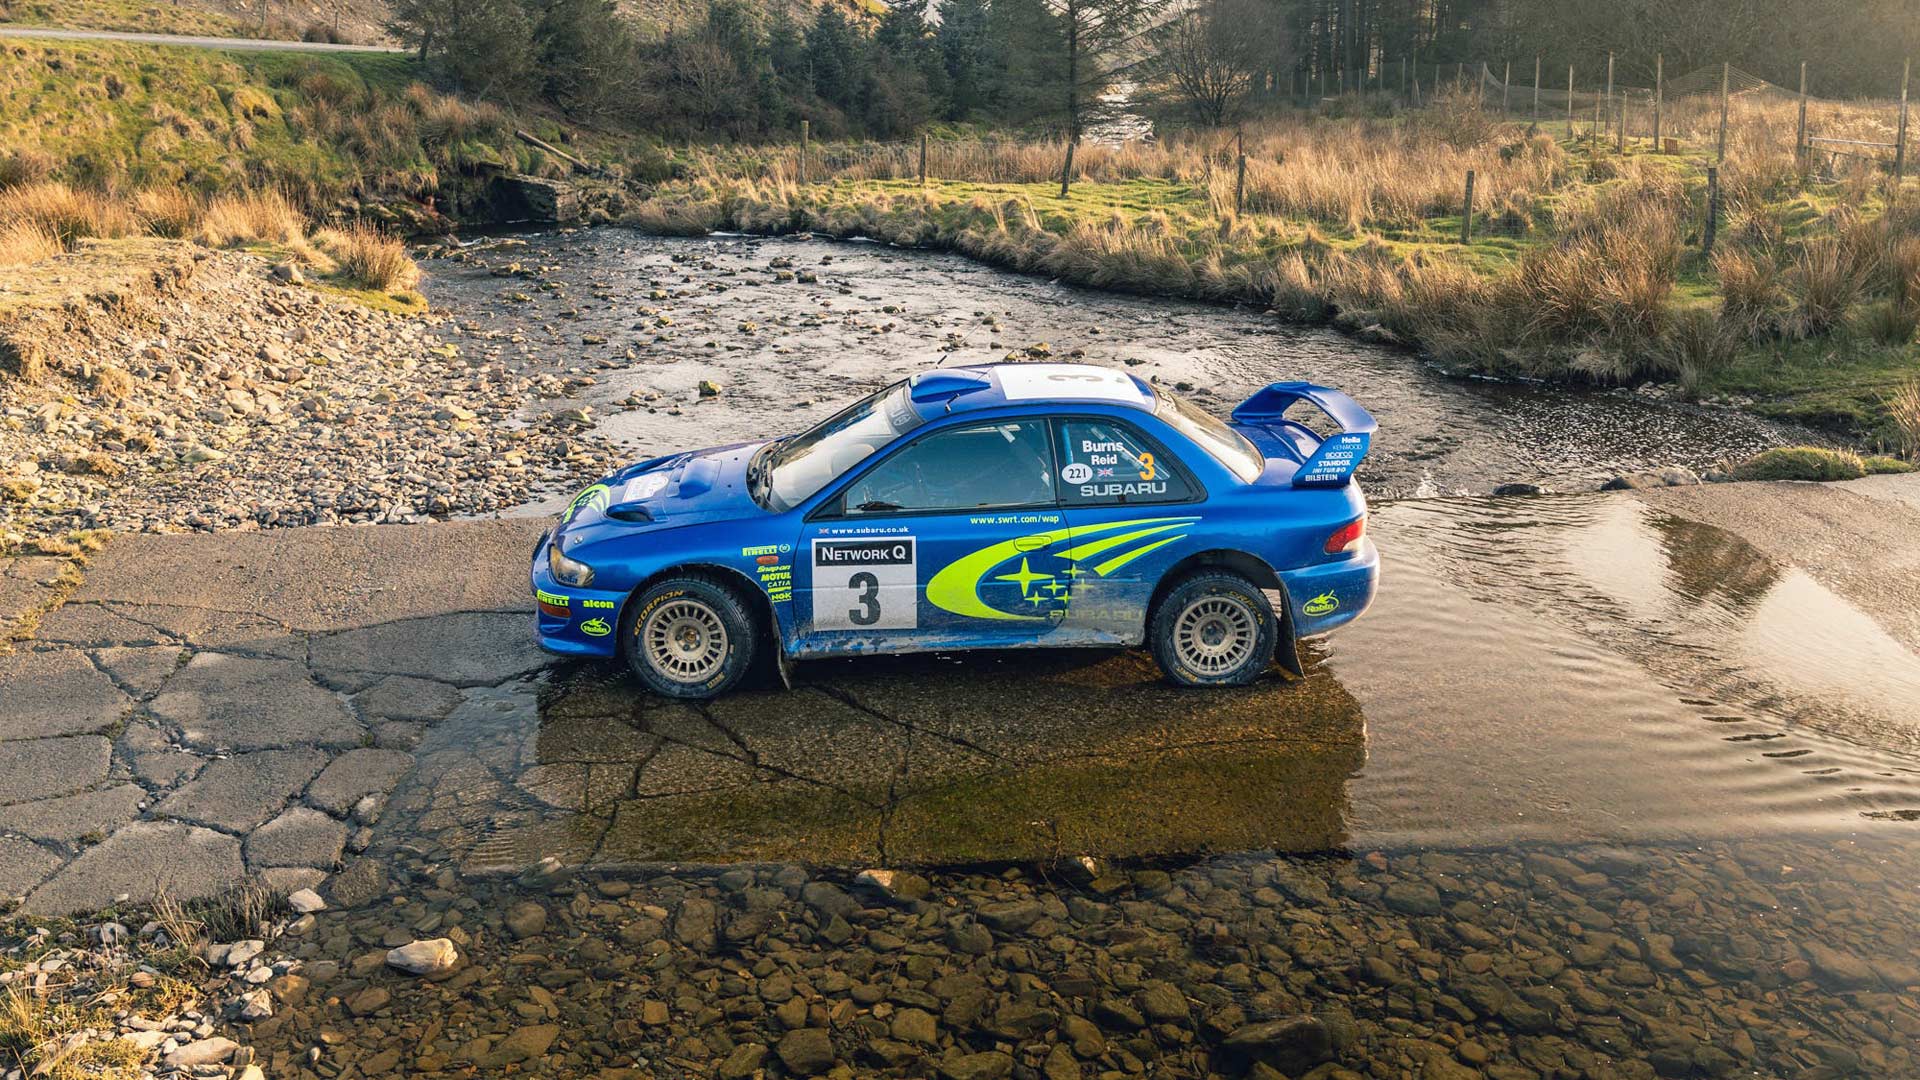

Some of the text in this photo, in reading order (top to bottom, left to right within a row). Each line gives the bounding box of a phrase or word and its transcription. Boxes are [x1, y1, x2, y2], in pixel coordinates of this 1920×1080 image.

[1082, 440, 1123, 453] Burns
[1091, 455, 1118, 465] Reid
[1138, 452, 1155, 481] 3
[1069, 468, 1086, 478] 221
[1080, 482, 1166, 496] SUBARU
[970, 514, 1059, 524] www.swrt.com/wap
[742, 545, 777, 556] PIRELLI
[892, 545, 906, 560] Q
[760, 572, 791, 582] MOTUL
[583, 599, 614, 608] alcon
[848, 571, 881, 625] 3
[633, 590, 684, 636] SCORPION
